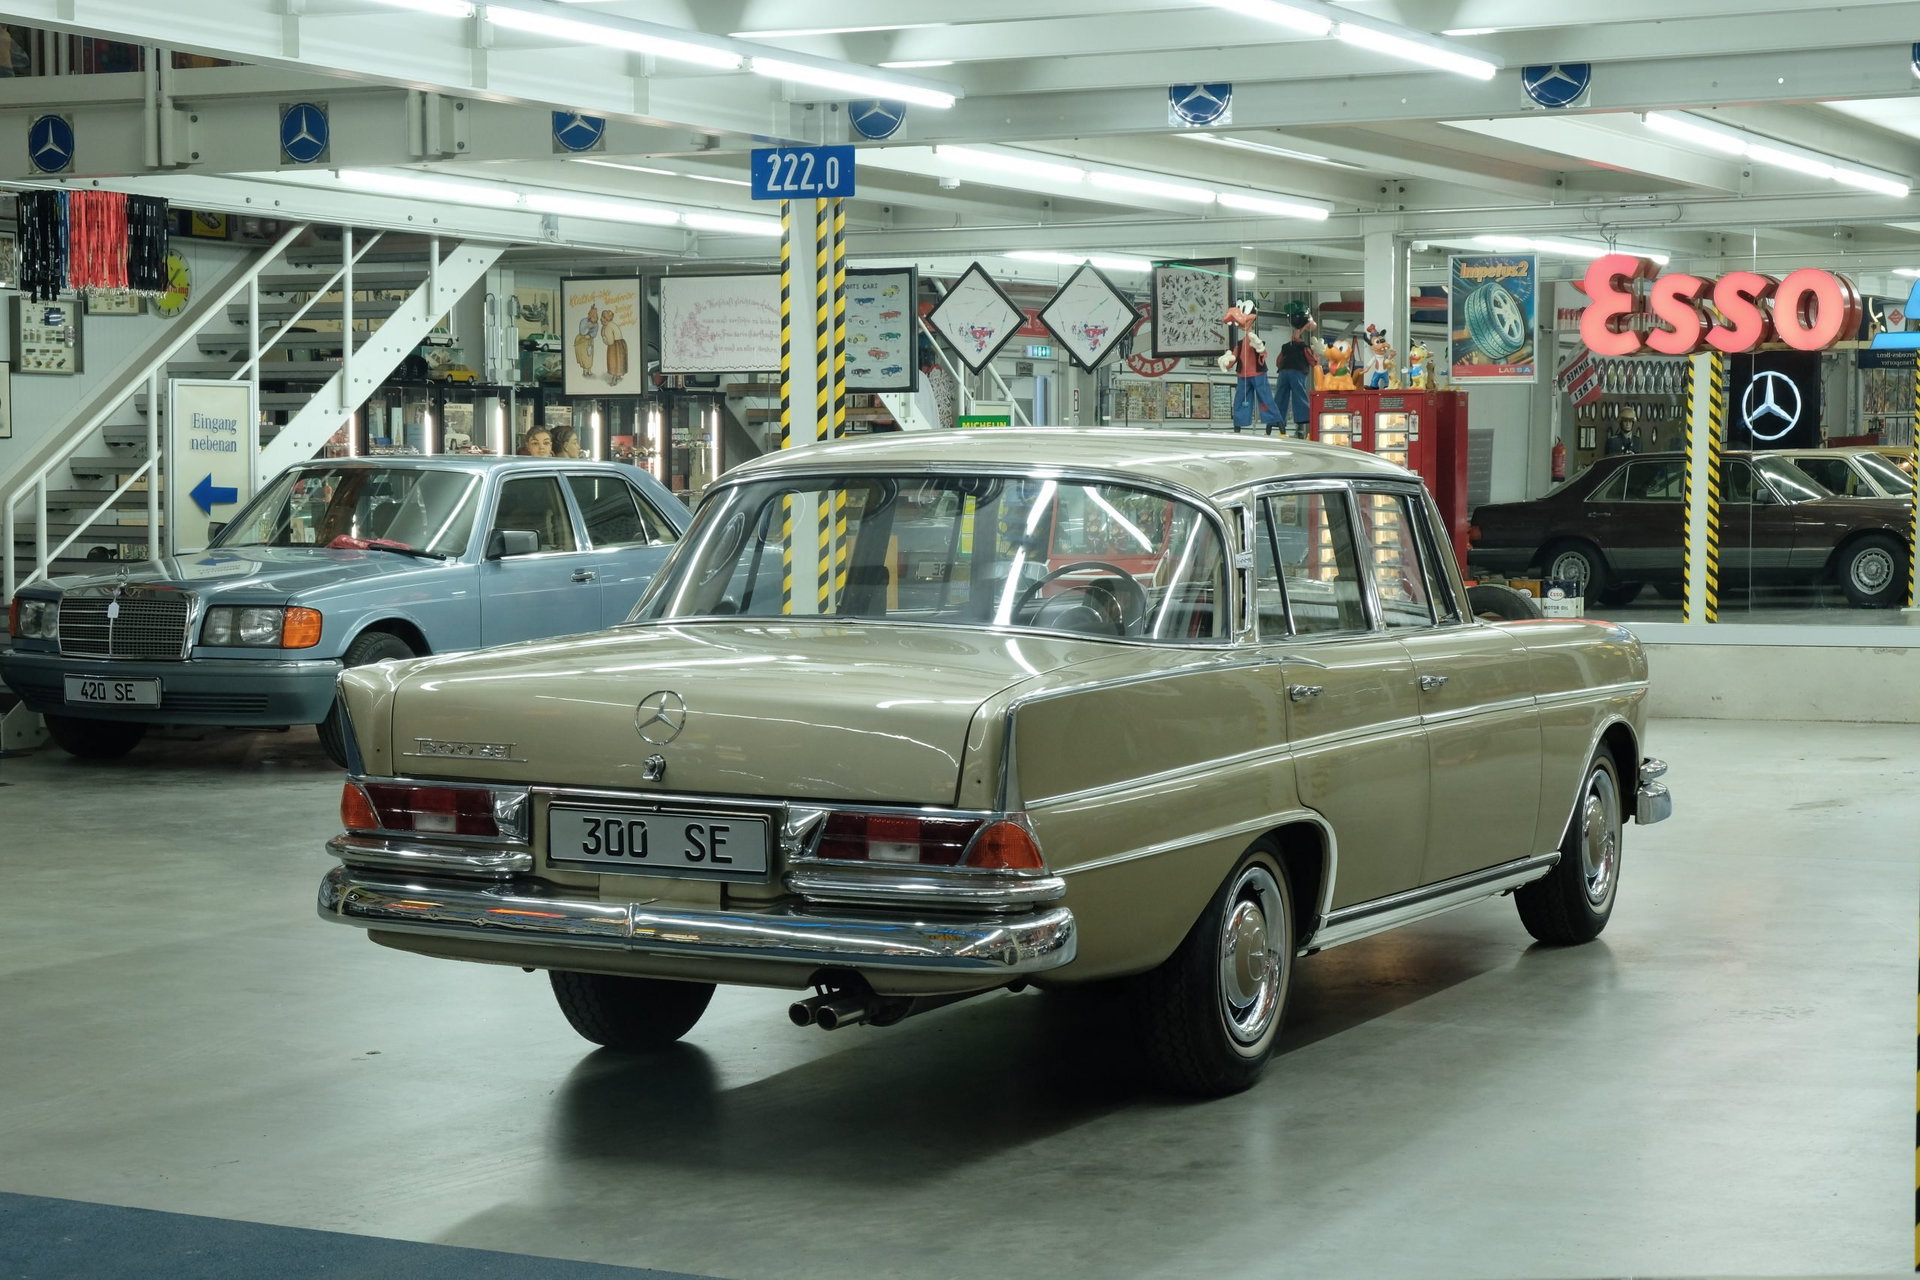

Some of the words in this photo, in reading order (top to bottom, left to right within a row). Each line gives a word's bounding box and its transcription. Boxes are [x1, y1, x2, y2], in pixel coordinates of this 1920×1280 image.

[766, 152, 840, 194] 222,0
[192, 412, 237, 435] Eingang
[191, 435, 237, 452] nebenan
[81, 681, 107, 701] 420
[114, 683, 136, 702] SE
[582, 816, 648, 859] 300
[684, 822, 733, 865] SE
